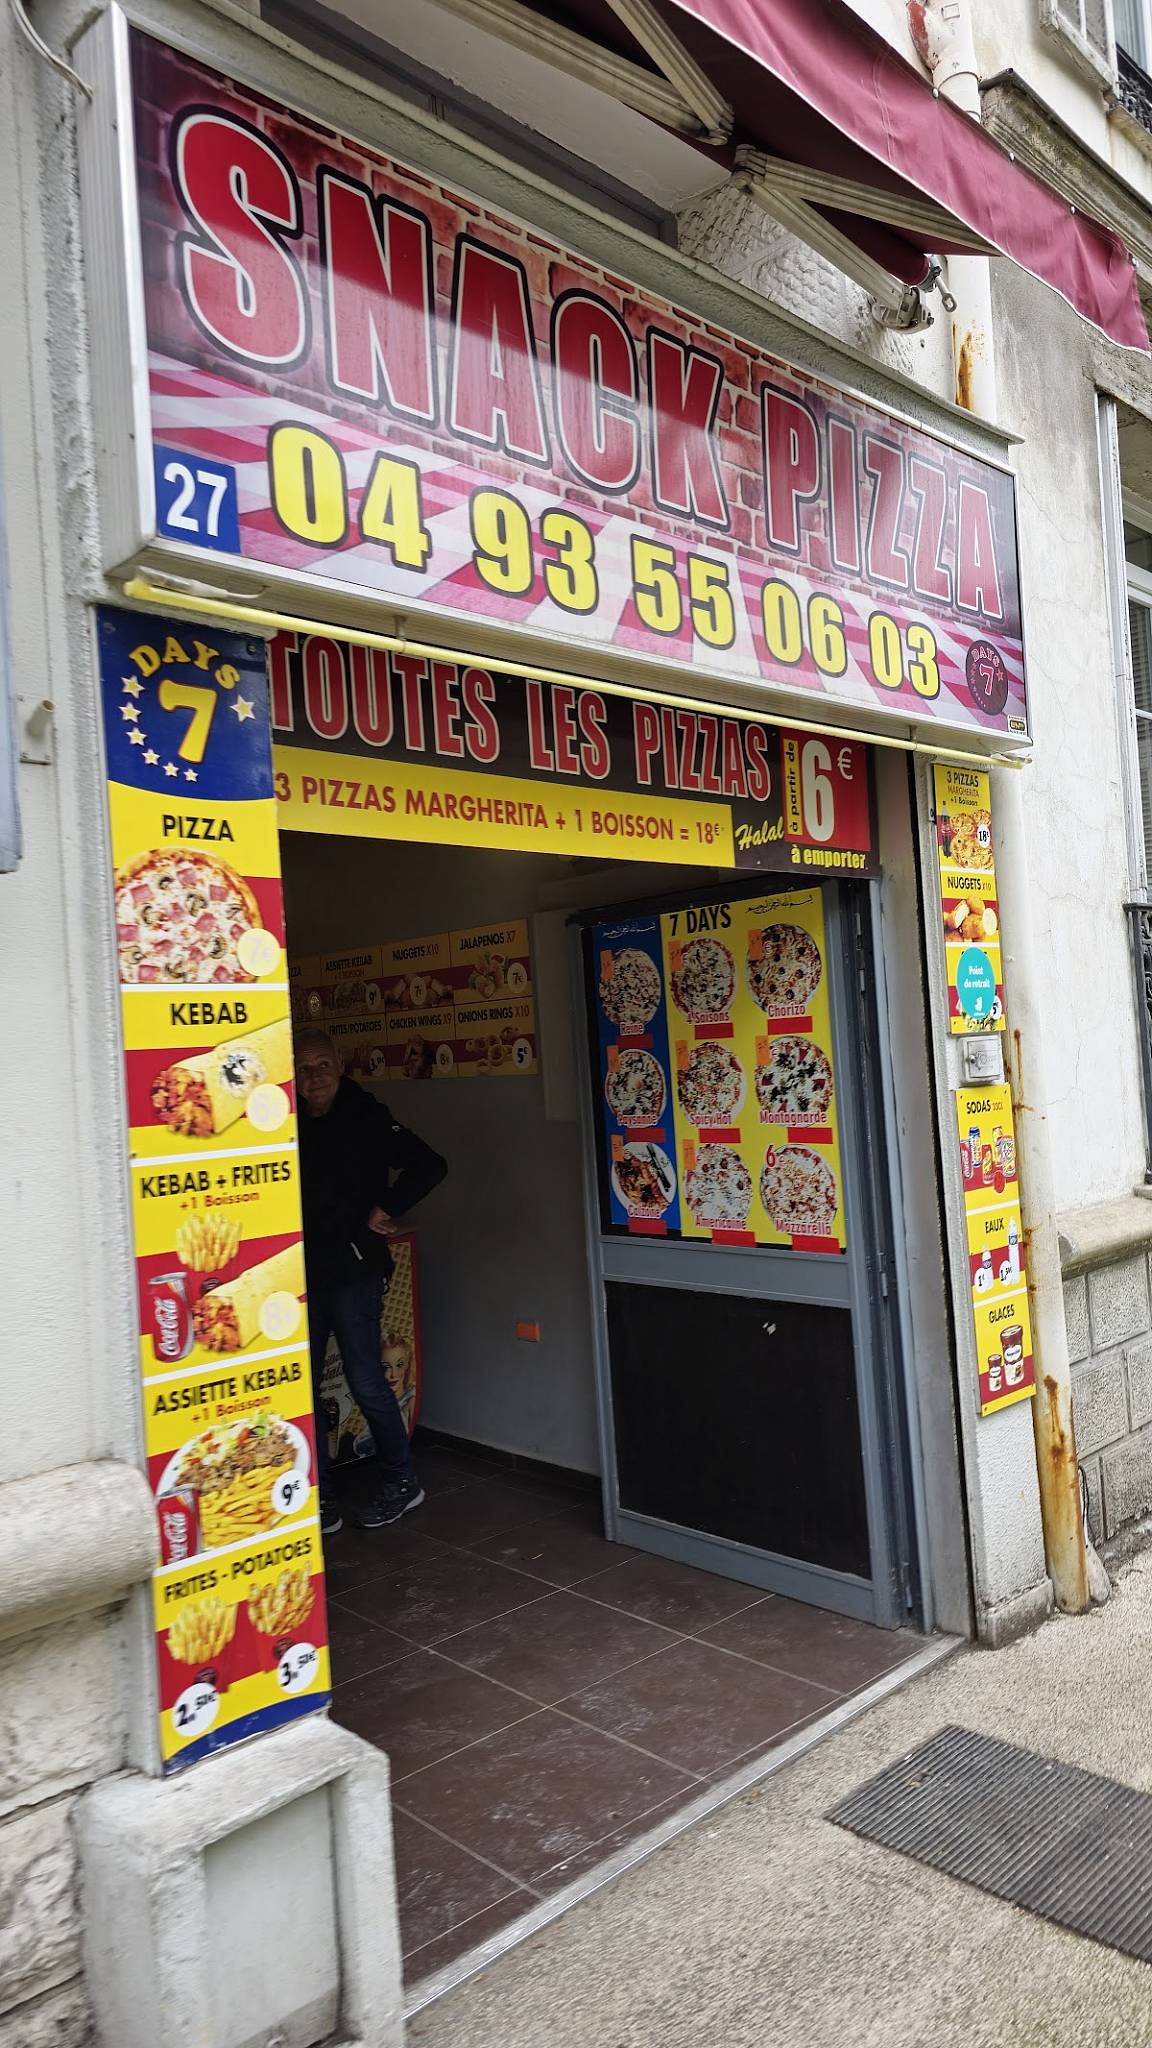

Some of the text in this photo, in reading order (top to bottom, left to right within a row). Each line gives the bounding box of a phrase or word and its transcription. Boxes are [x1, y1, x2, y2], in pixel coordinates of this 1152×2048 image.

[168, 105, 1004, 620] SNACK PIZZA
[163, 462, 229, 537] 27
[267, 420, 940, 699] 04 93 55 06 03
[129, 636, 240, 690] DAYS
[971, 646, 1000, 667] DAYS
[980, 663, 994, 695] 7
[159, 679, 217, 764] 7
[267, 629, 771, 802] TOUTES LES PIZZAS
[788, 742, 797, 762] de
[802, 739, 853, 841] 6€
[947, 771, 979, 787] 3 PIZZAS
[788, 765, 799, 816] partir
[947, 786, 979, 798] MARGHERITA
[274, 772, 720, 845] 3 PIZZAS MARGHERITA + 1 BOISSON = 18€
[162, 815, 235, 842] PIZZA
[735, 815, 785, 851] Halal
[791, 846, 866, 869] à emporter
[947, 876, 981, 890] NUGGETS
[669, 914, 679, 937] 7
[687, 904, 732, 933] DAYS
[459, 930, 516, 950] JALAPENOS X7
[392, 945, 425, 960] NUGGETS
[968, 965, 984, 976] Point
[963, 979, 990, 988] de retrait
[171, 1002, 248, 1026] KEBAB
[389, 1016, 417, 1029] CHICKEN
[418, 1014, 441, 1026] WINGS
[457, 1009, 488, 1023] ONIONS
[768, 1004, 805, 1017] Chorizo
[760, 1110, 827, 1125] Montagnarde
[966, 1099, 991, 1114] SODAS
[140, 1161, 291, 1199] KEBAB + FRITES
[204, 1191, 260, 1208] Boisson
[776, 1218, 832, 1235] Mozzarella
[984, 1217, 1005, 1234] EAUX
[988, 1304, 1015, 1324] GLACES
[153, 1377, 236, 1416] ASSIETTE
[243, 1363, 302, 1394] KEBAB
[215, 1396, 272, 1418] Boisson
[282, 1480, 301, 1506] 9€
[163, 1569, 218, 1603] FRITES
[231, 1537, 312, 1580] POTATOES
